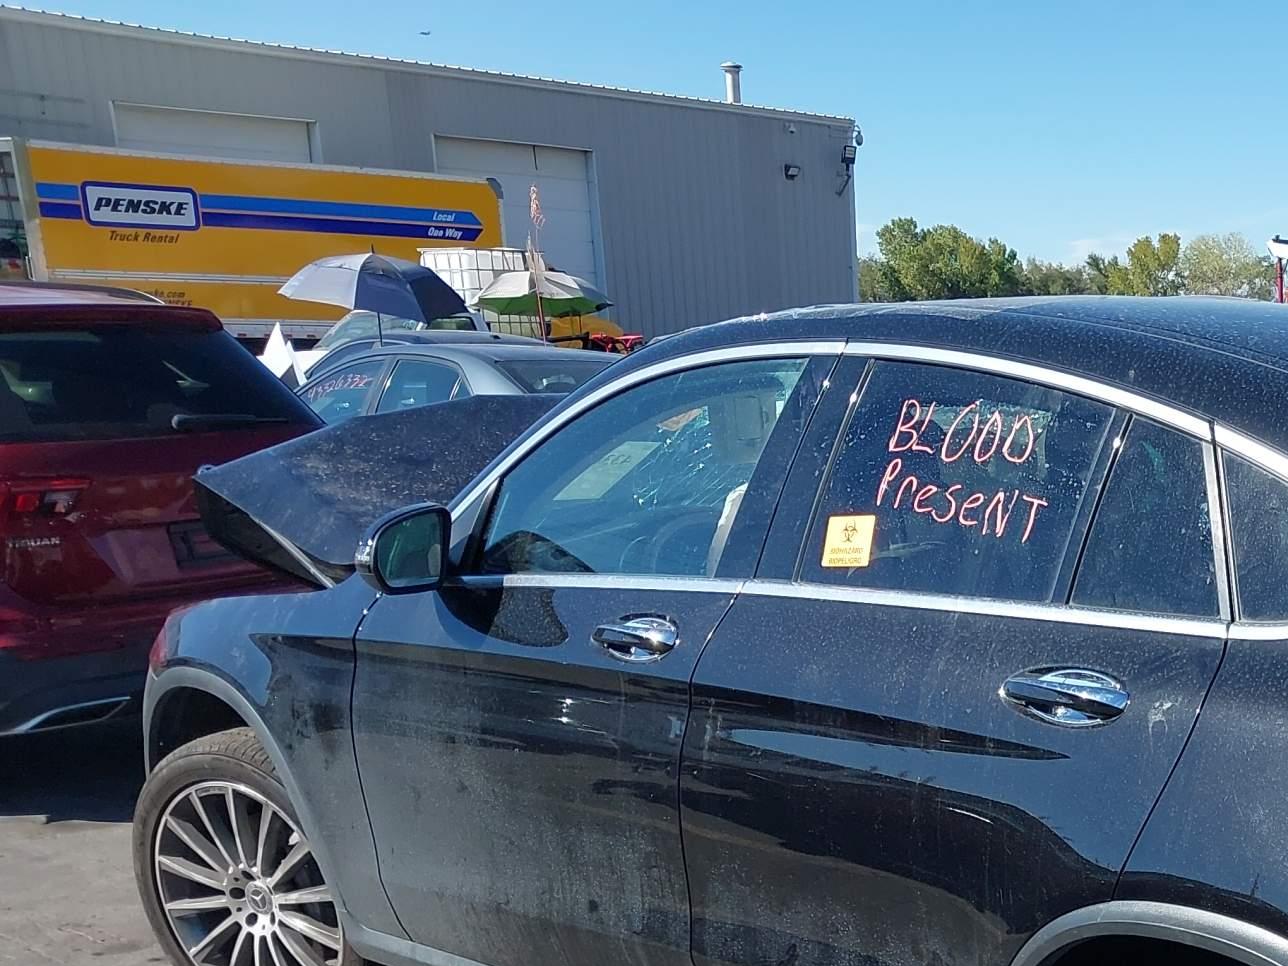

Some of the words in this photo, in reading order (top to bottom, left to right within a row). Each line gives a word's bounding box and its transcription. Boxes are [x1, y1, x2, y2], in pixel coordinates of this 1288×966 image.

[94, 196, 189, 216] PENSKE
[432, 211, 456, 222] Local
[109, 230, 140, 242] Truck
[143, 232, 180, 244] Rental
[428, 226, 444, 237] One
[445, 227, 463, 240] Way
[888, 399, 1034, 463] BLOOD
